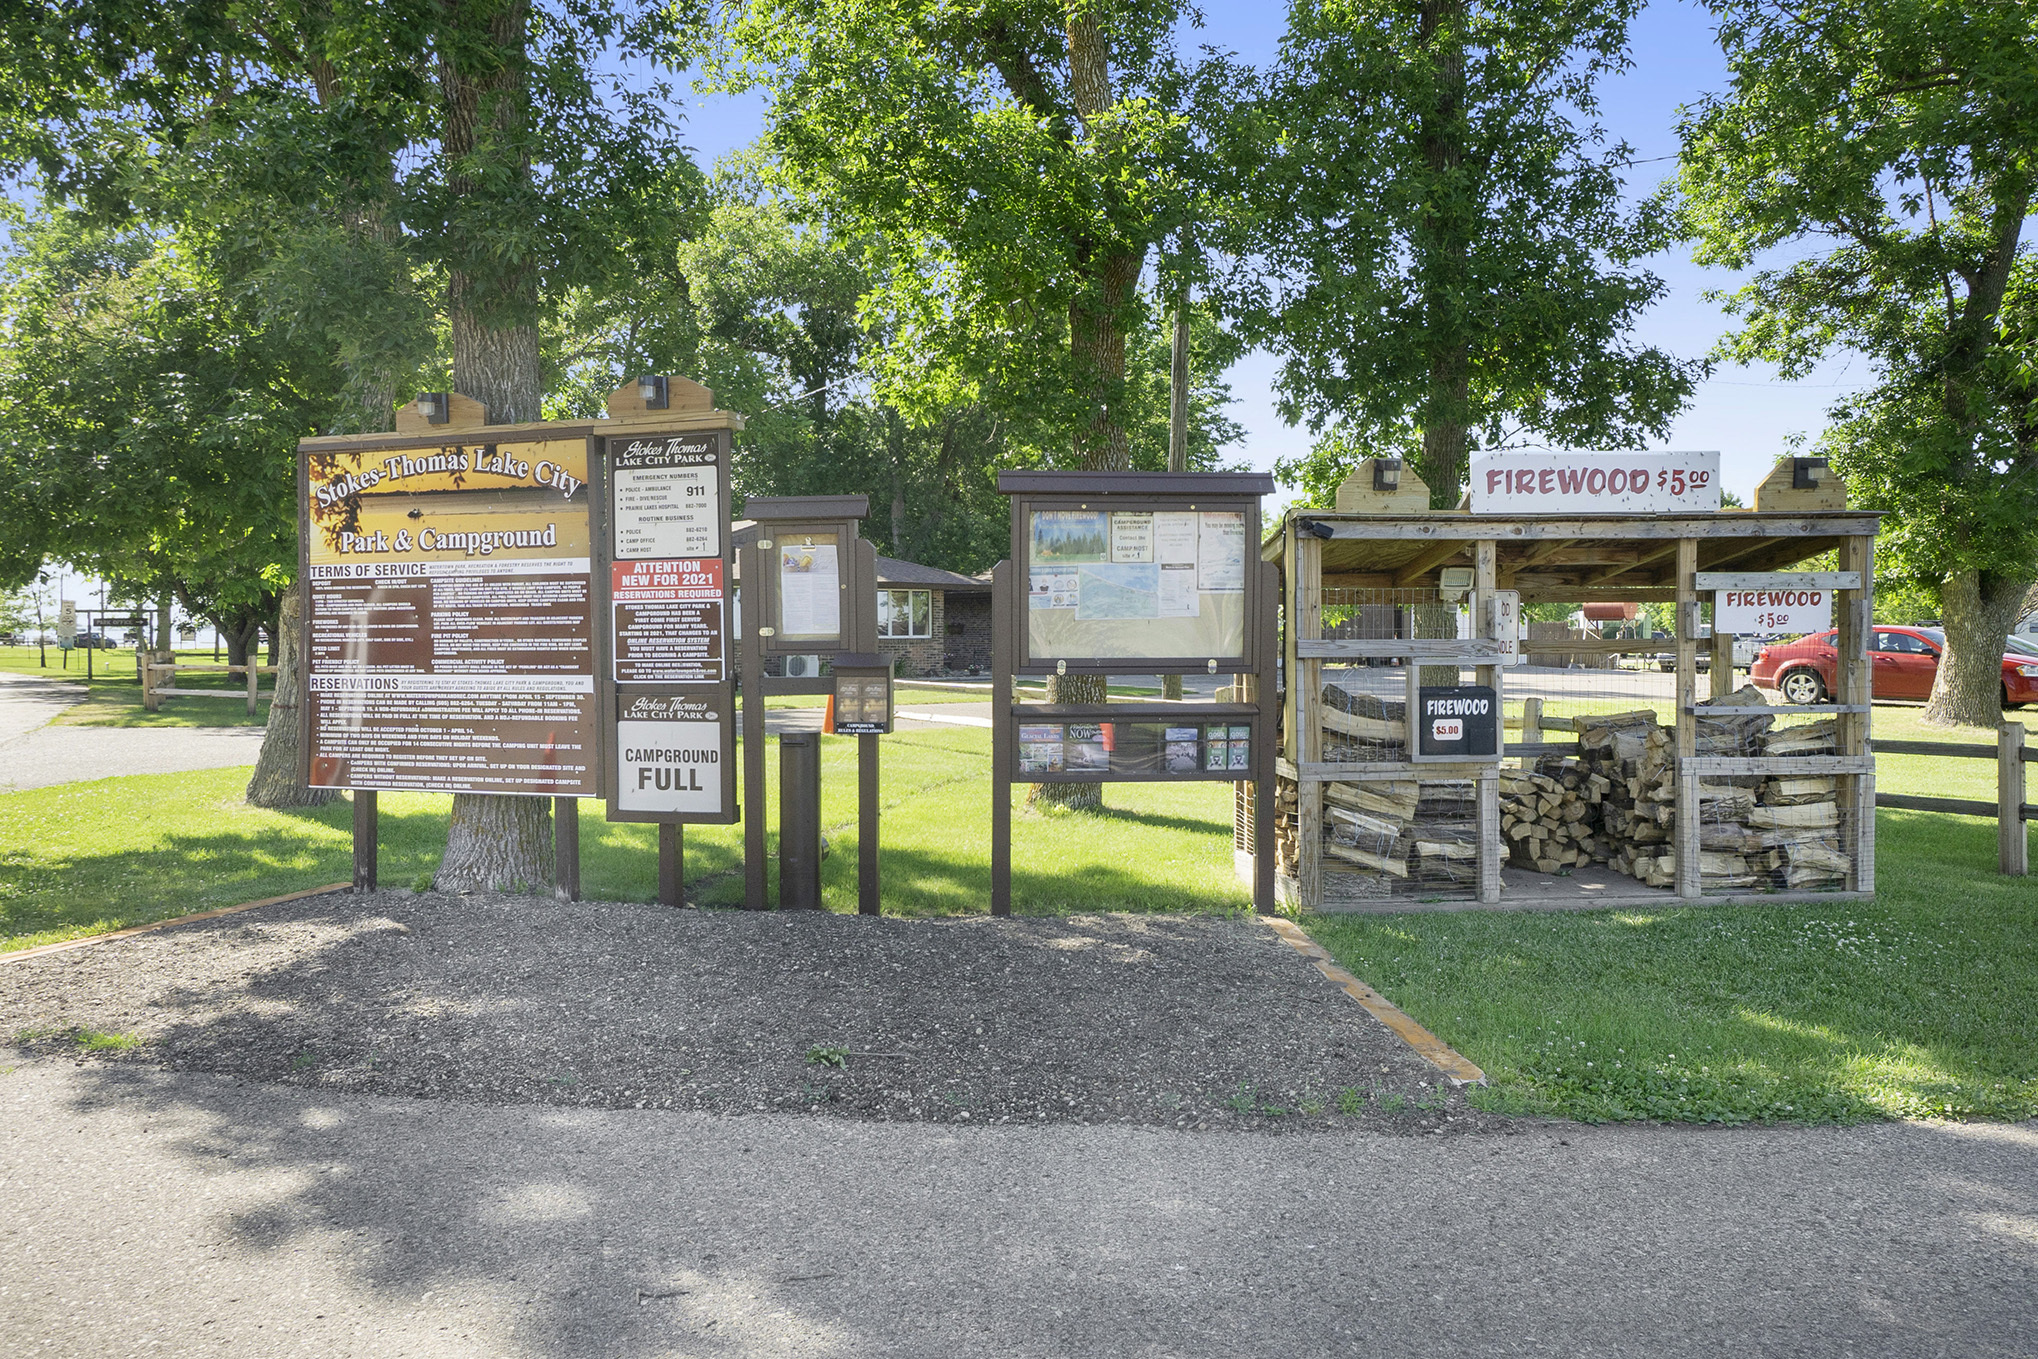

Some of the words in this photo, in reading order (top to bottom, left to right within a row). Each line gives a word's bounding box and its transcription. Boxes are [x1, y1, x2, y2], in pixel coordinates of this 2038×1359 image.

[624, 440, 663, 458] Stokes
[665, 438, 707, 456] Thomas
[616, 458, 642, 467] LAKE
[645, 456, 671, 465] CITY
[674, 455, 703, 464] PARK
[316, 452, 469, 509] Stokes-Thomas
[474, 448, 529, 478] Lake
[534, 460, 582, 499] City
[1486, 467, 1649, 495] FIREWOOD
[686, 486, 705, 496] 911
[340, 530, 389, 553] Park
[393, 529, 413, 550] &
[418, 523, 557, 555] Campground
[311, 566, 351, 578] TERMS
[356, 565, 370, 577] OF
[375, 564, 426, 576] SERVICE
[634, 561, 700, 574] ATTENTION
[622, 575, 650, 587] NEW
[653, 574, 678, 586] FOR
[682, 573, 713, 585] 2021
[613, 590, 676, 599] RESERVATIONS
[678, 589, 722, 598] REQUIRED
[1726, 591, 1822, 607] FIREWOOD
[311, 678, 399, 690] RESERVATIONS
[631, 697, 667, 711] Stokes
[669, 697, 707, 712] Thomas
[1427, 699, 1489, 716] FIREWOOD
[624, 710, 648, 719] LAKE
[651, 711, 675, 719] CITY
[677, 711, 703, 719] PARK
[1070, 729, 1091, 739] NOW
[1436, 725, 1459, 735] $5.00
[625, 748, 719, 763] CAMPGROUND
[638, 767, 703, 791] FULL
